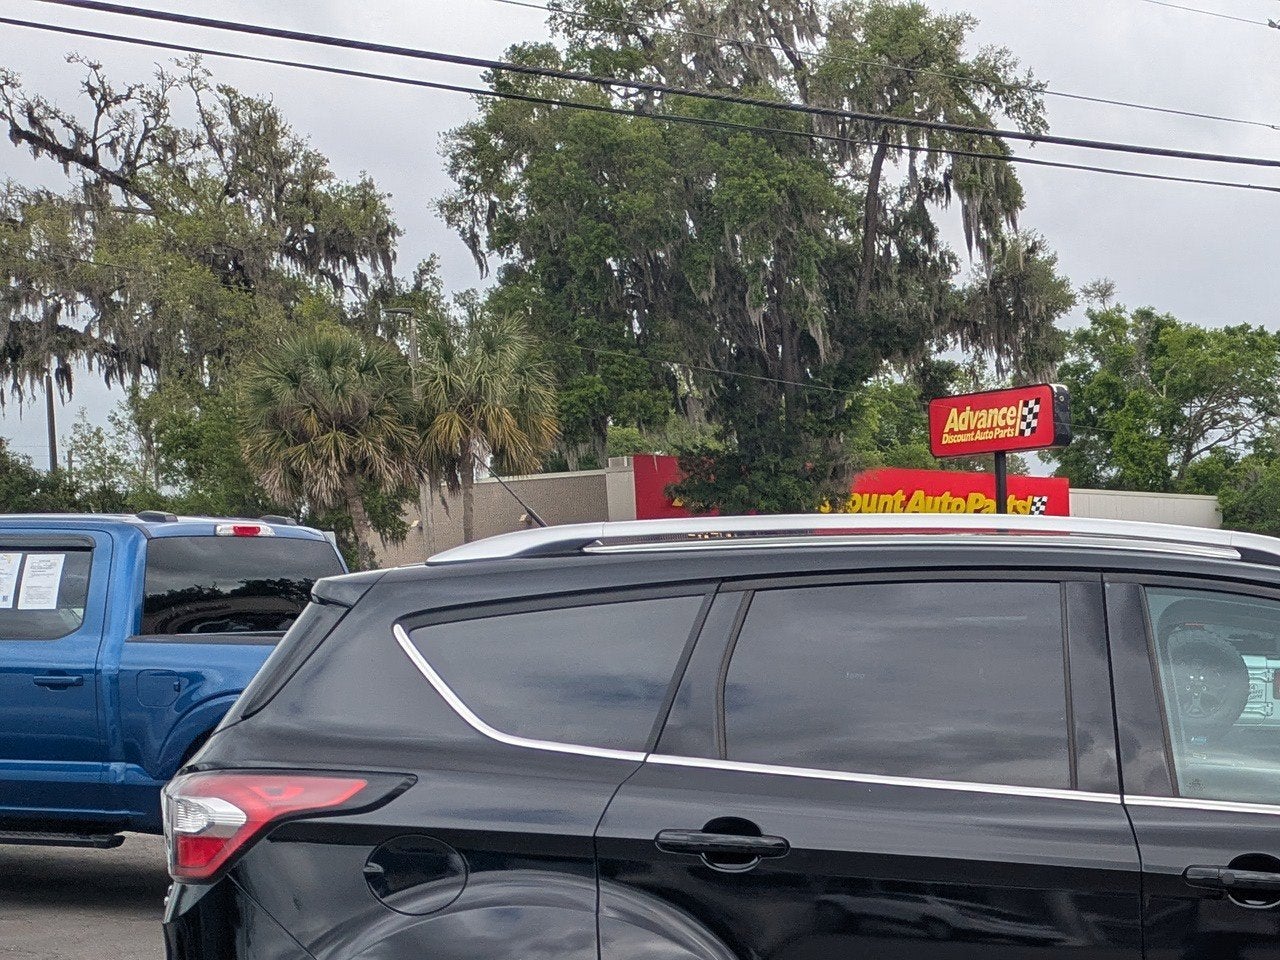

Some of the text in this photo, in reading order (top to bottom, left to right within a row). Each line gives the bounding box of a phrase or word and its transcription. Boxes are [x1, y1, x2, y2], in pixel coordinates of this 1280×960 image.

[943, 405, 1017, 433] Advance
[941, 427, 1016, 445] Discount Auto Parts
[904, 490, 966, 514] Auto
